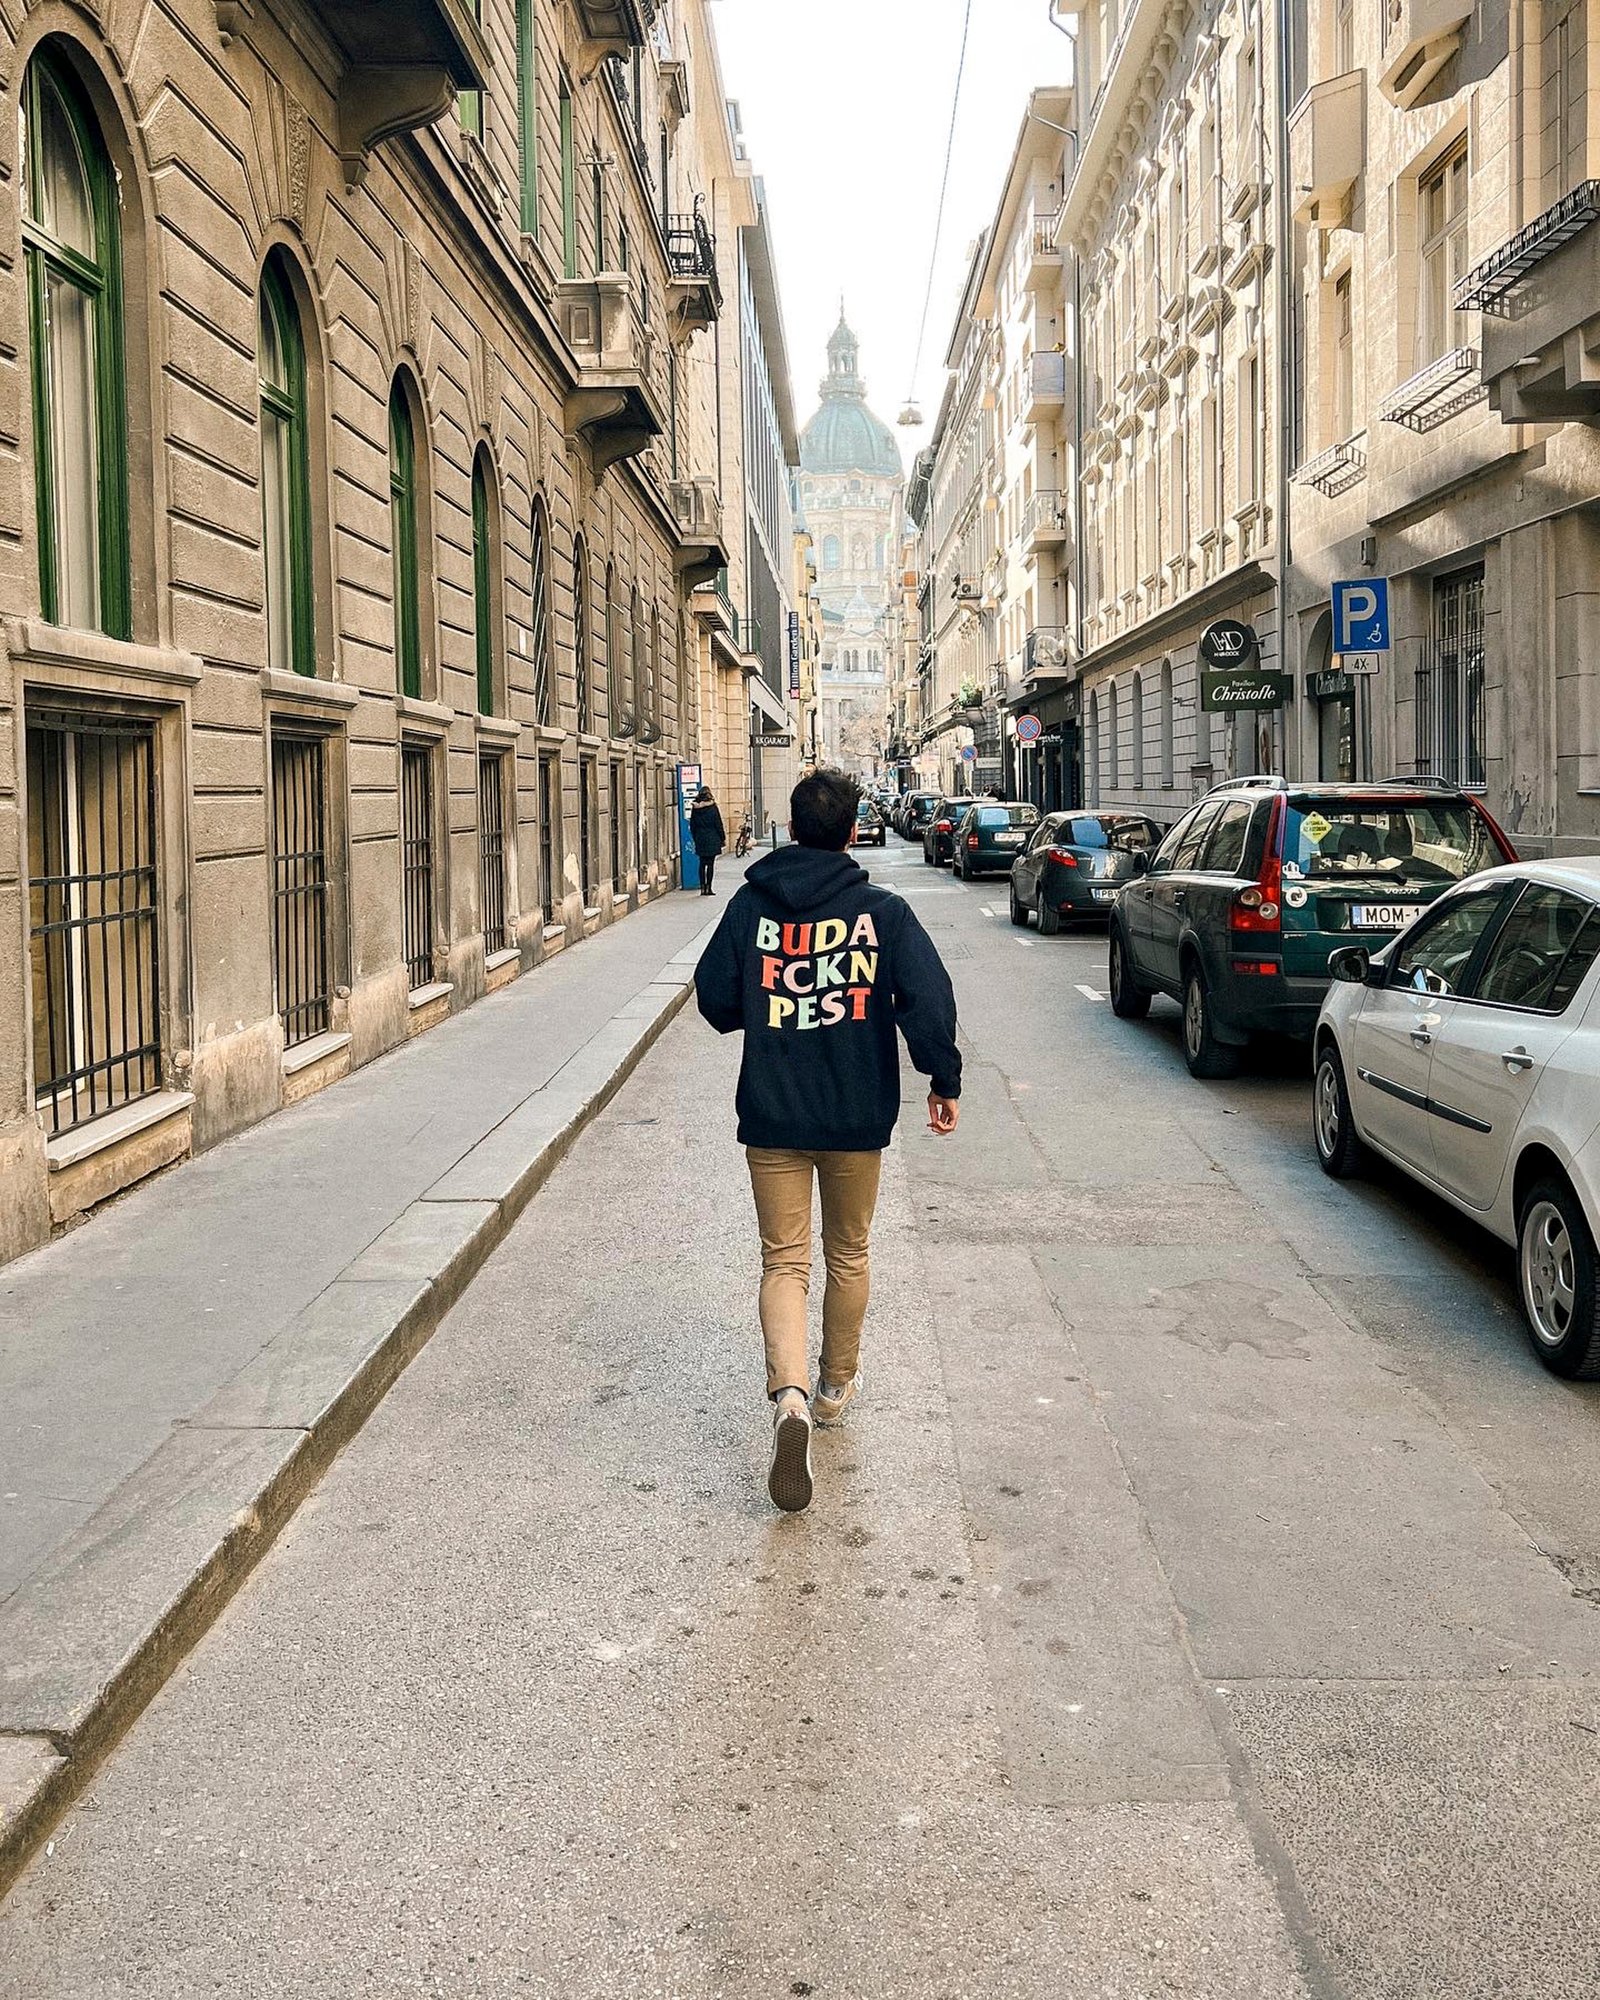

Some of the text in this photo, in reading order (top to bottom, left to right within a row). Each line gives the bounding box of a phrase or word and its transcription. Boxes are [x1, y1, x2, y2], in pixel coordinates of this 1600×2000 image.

[1342, 587, 1377, 645] P
[790, 629, 798, 660] Garden
[791, 661, 799, 688] Hilton
[1211, 684, 1276, 701] Christofle
[756, 913, 879, 956] BUDA
[760, 950, 879, 994] FCKN
[767, 987, 871, 1030] PEST
